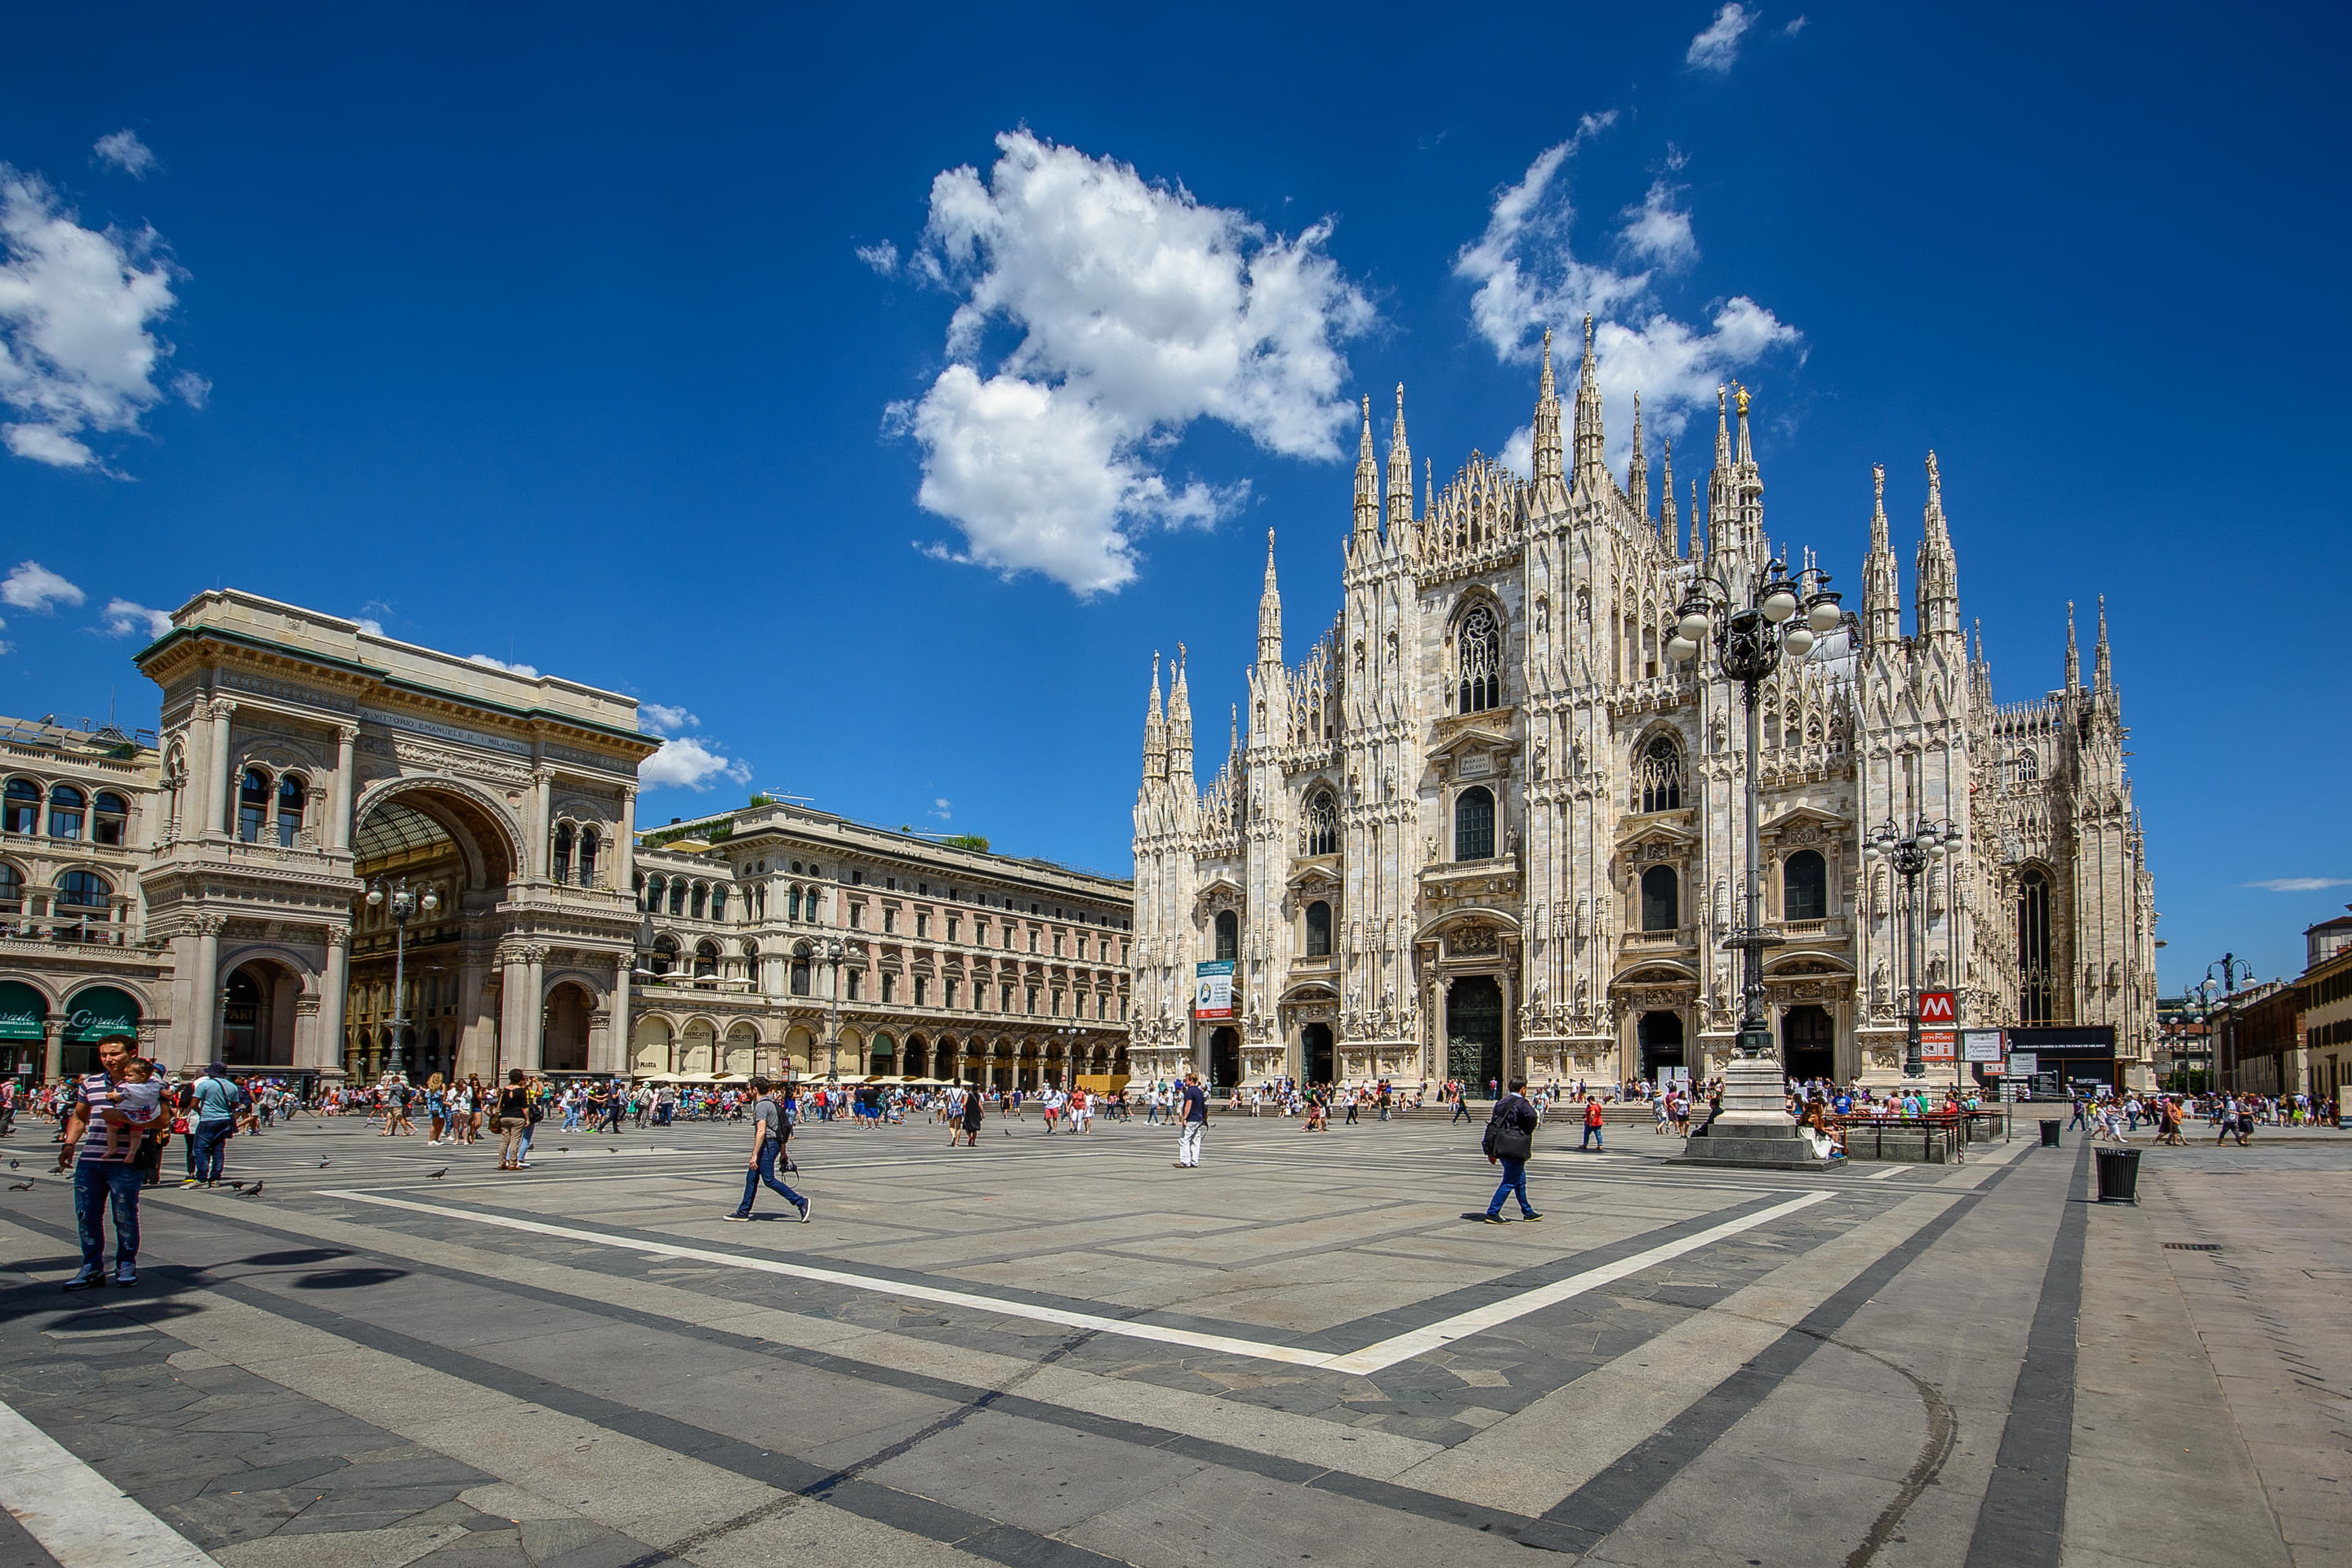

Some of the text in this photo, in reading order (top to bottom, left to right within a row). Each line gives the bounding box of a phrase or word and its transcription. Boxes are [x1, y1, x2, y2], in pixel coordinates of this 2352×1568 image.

[375, 713, 414, 727] VITTORIO
[418, 723, 464, 738] EMANUELE
[488, 737, 523, 751] MILANESI
[1922, 997, 1953, 1017] M
